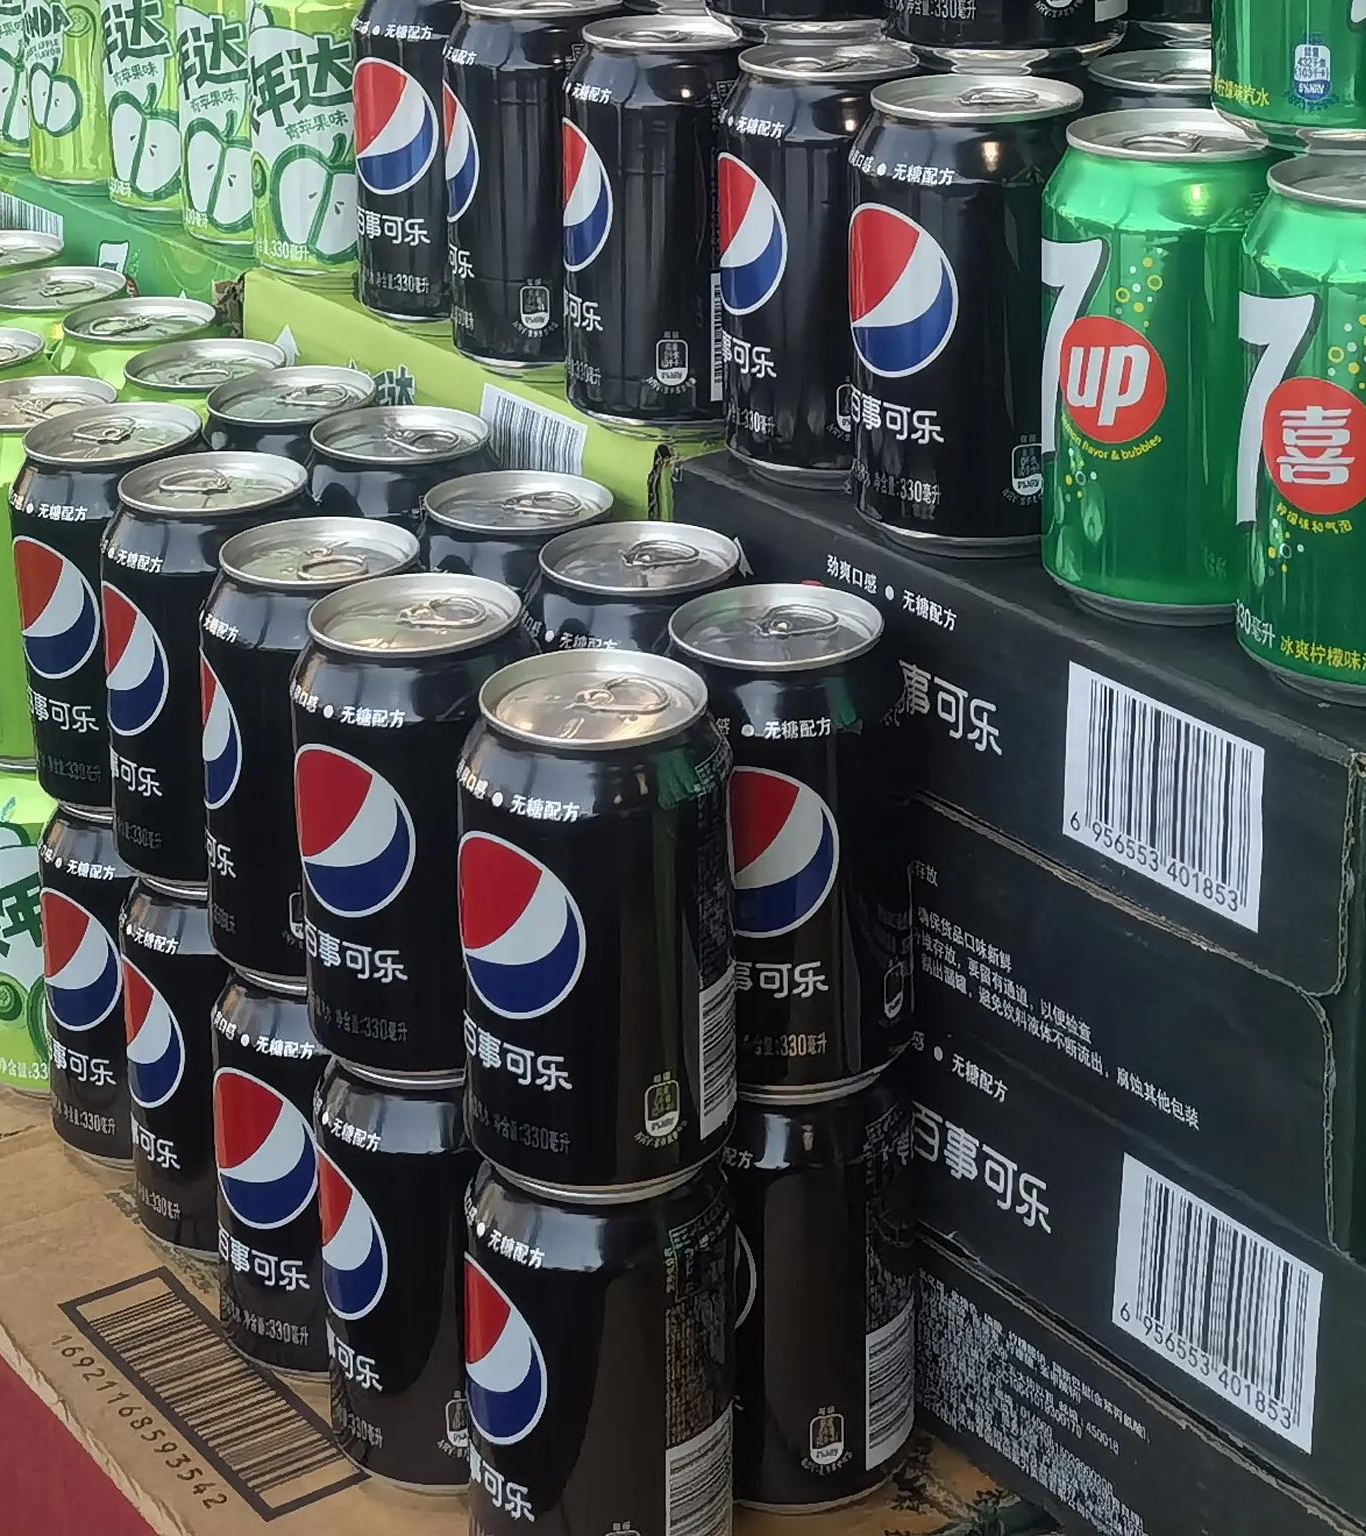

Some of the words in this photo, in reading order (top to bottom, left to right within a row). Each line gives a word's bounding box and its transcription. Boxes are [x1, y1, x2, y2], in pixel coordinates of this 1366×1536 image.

[383, 22, 433, 41] 无糖配方
[571, 81, 612, 105] 无糖配方
[284, 110, 350, 142] 青苹果味
[735, 114, 785, 141] 无糖配方
[891, 161, 956, 187] 无糖配方
[356, 208, 432, 249] 百事可乐
[1041, 237, 1105, 456] 7
[1066, 343, 1150, 427] up
[851, 387, 945, 446] 百事可乐
[1237, 291, 1319, 526] 7
[1121, 432, 1164, 461] bubbles
[1275, 405, 1355, 486] 喜
[36, 501, 89, 522] 无糖配方
[114, 548, 164, 575] 无糖配方
[826, 553, 879, 596] 劲爽口感
[902, 589, 958, 632] 无糖配方
[340, 703, 406, 729] 无糖配方
[764, 716, 834, 741] 无糖配方
[509, 792, 582, 823] 无糖配方
[64, 858, 116, 882] 无糖配方
[1070, 811, 1081, 832] 6
[1091, 823, 1161, 875] 956553
[1166, 860, 1240, 913] 401853
[132, 928, 181, 956] 无糖配方
[303, 921, 410, 985] 百事可乐
[255, 1033, 315, 1061] 无糖配方
[462, 1010, 574, 1093] 百事可乐
[950, 1053, 1009, 1104] 无糖配方
[329, 1116, 383, 1153] 无糖配方
[912, 1099, 1053, 1235] 百事可乐
[217, 1227, 311, 1294] 百事可乐
[486, 1228, 546, 1269] 无糖配方
[1119, 1301, 1132, 1324] 6
[1143, 1315, 1211, 1376] 956553
[1217, 1369, 1293, 1431] 401853
[48, 1333, 229, 1510] 16921168593542
